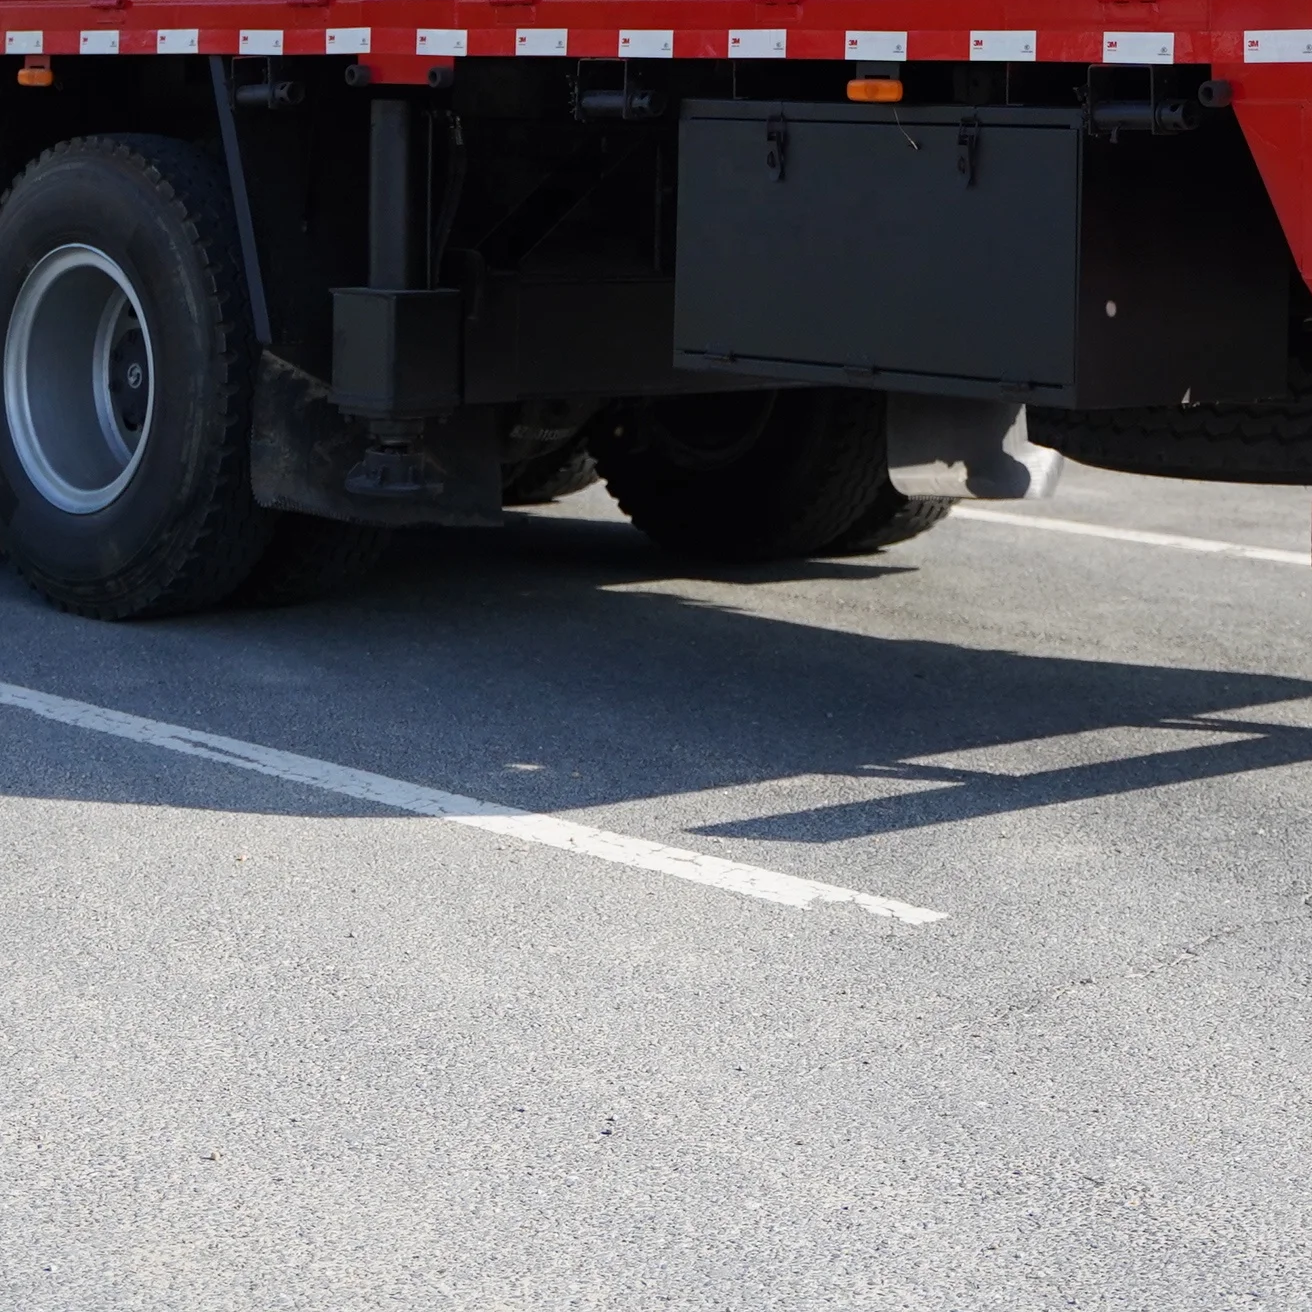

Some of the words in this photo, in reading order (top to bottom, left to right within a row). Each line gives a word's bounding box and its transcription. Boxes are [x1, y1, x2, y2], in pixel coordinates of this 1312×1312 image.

[731, 37, 741, 45] 3M
[848, 39, 858, 47] 3M
[973, 39, 984, 47] 3M
[1106, 40, 1118, 49] 3M
[1247, 39, 1259, 48] 3M
